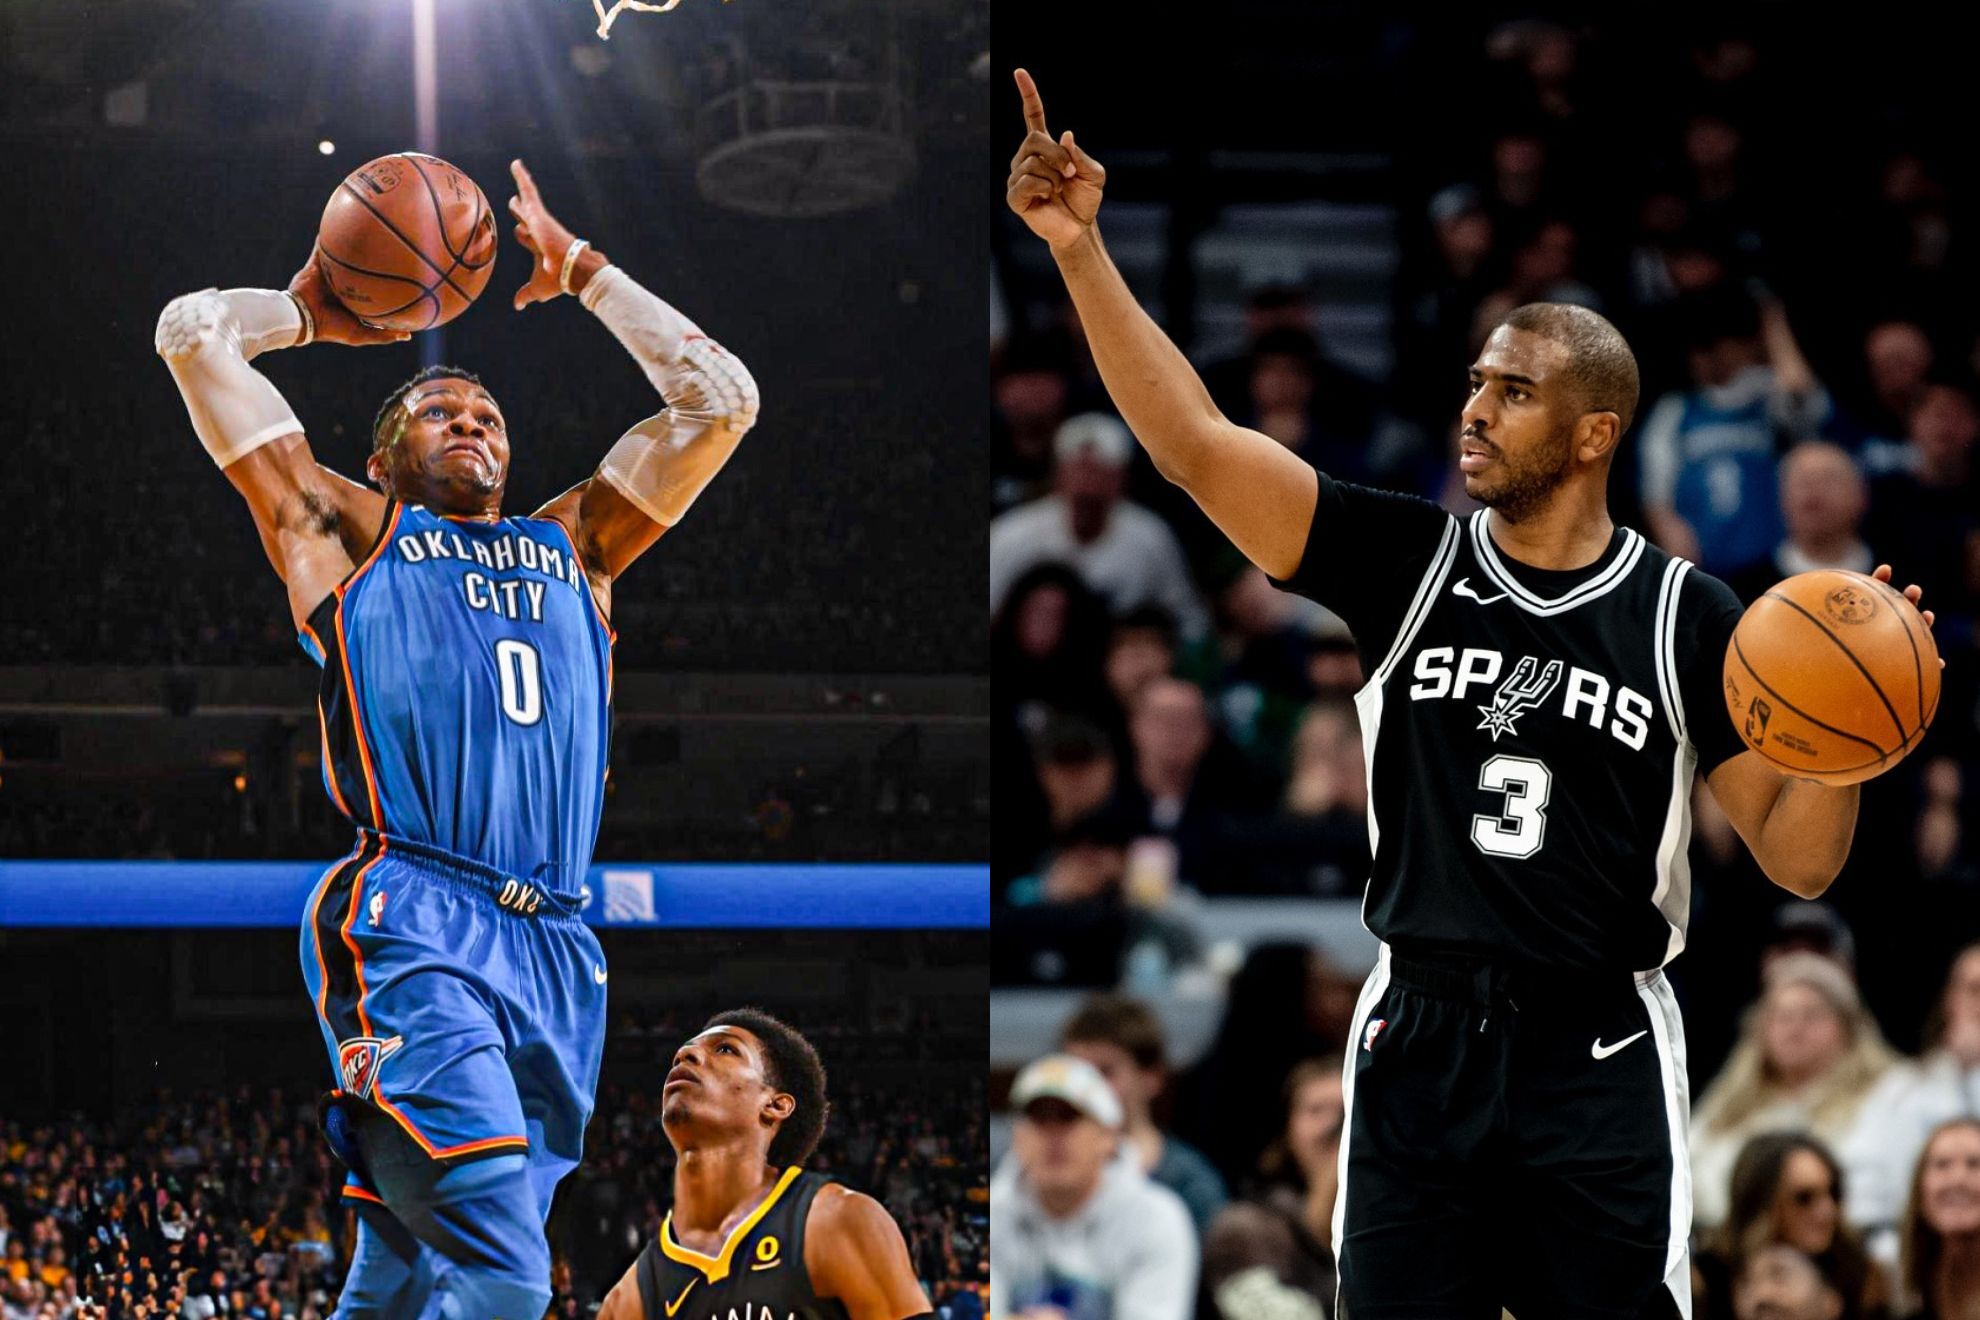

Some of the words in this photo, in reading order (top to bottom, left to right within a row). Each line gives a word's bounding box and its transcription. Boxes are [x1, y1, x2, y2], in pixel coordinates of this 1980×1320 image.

[397, 530, 580, 594] OKLAHOMA
[464, 571, 545, 621] CITY
[495, 638, 543, 727] 0
[1409, 646, 1653, 752] SPURS
[1470, 753, 1553, 860] 3
[756, 1236, 779, 1262] 0
